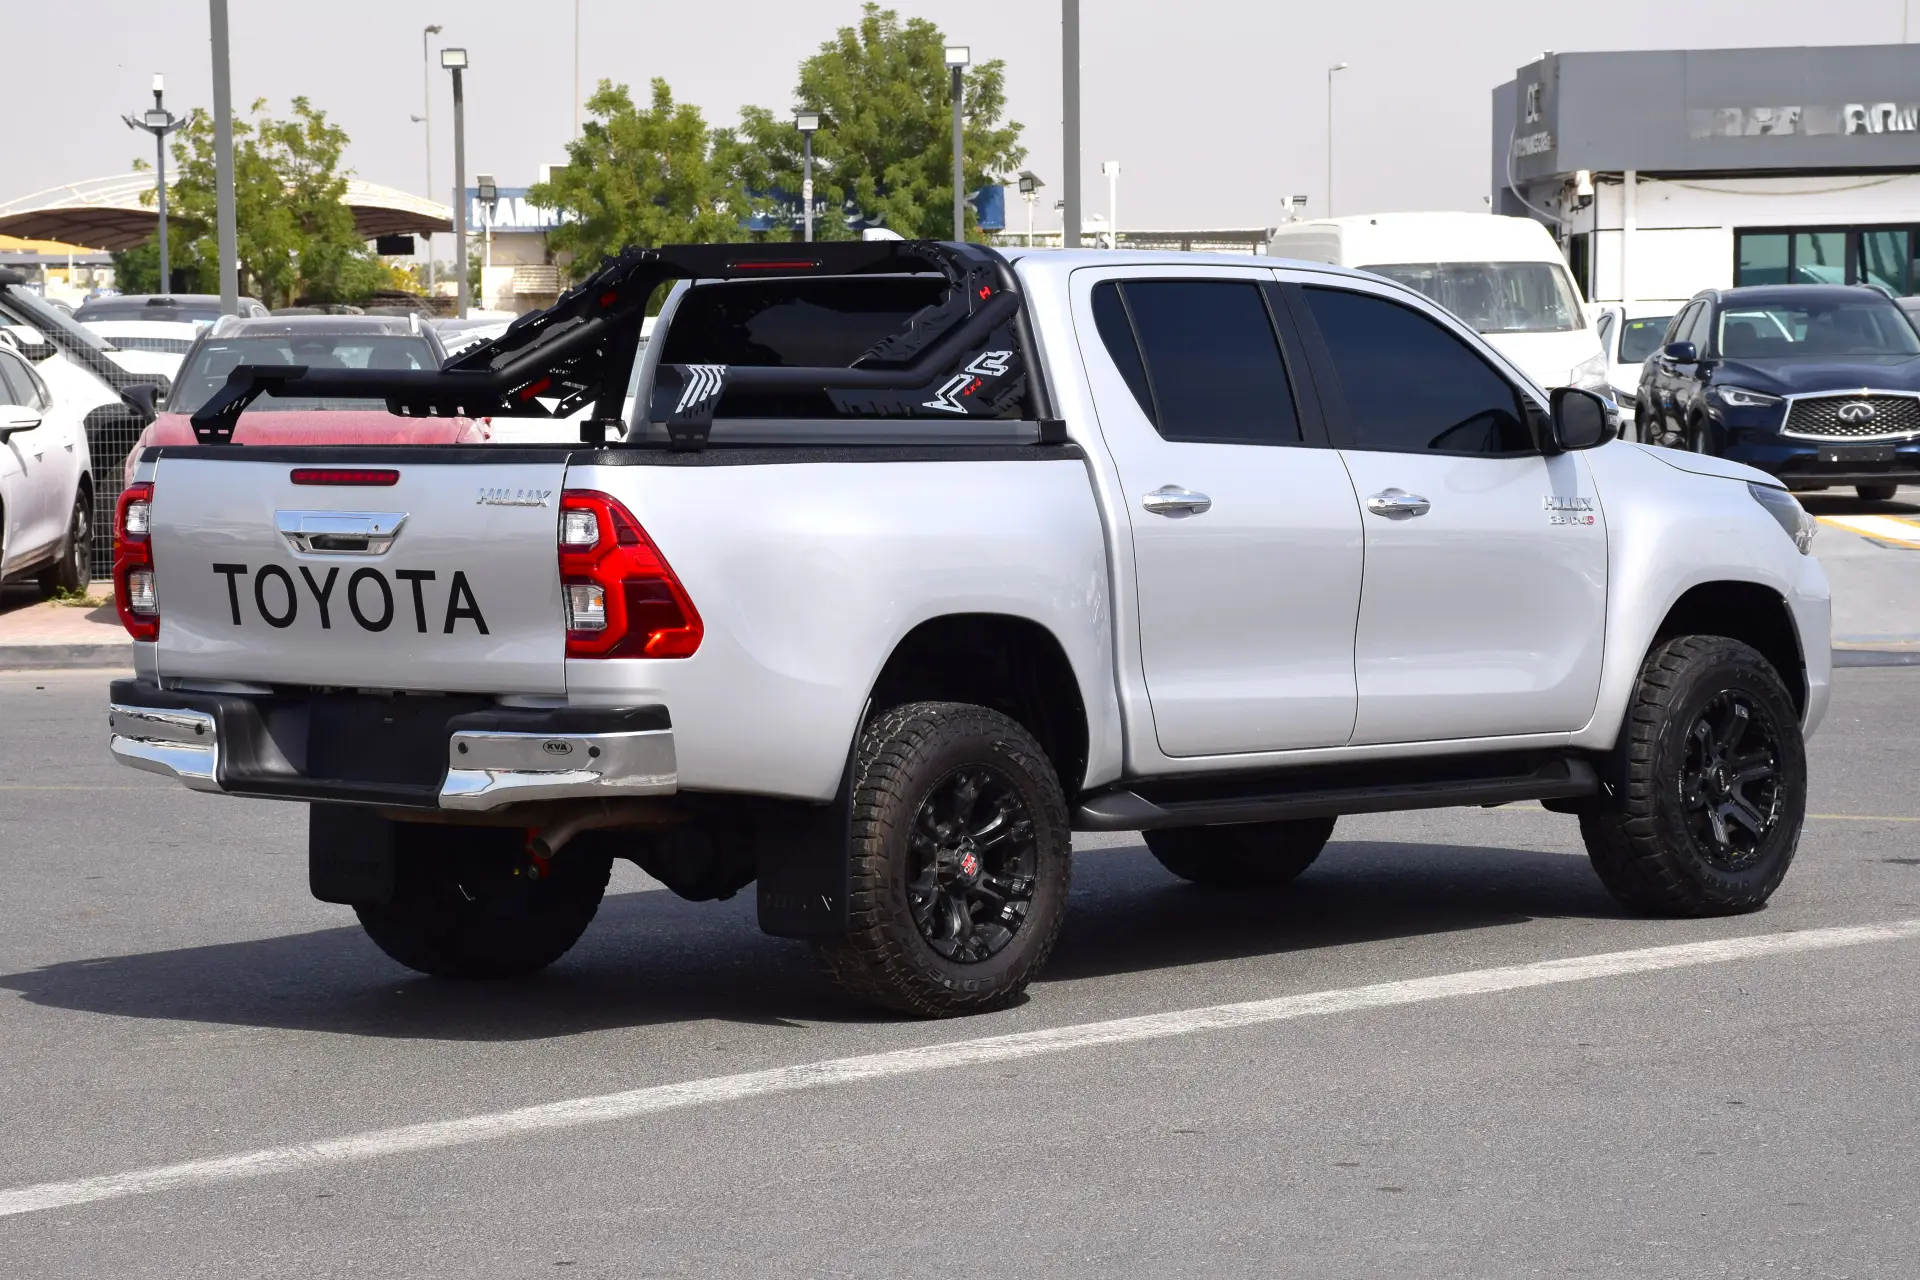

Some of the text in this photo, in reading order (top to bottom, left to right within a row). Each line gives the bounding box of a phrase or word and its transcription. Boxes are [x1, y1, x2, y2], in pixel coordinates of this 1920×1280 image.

[476, 487, 552, 508] HILUX
[1542, 495, 1594, 512] HILUX
[212, 563, 490, 635] TOYOTA
